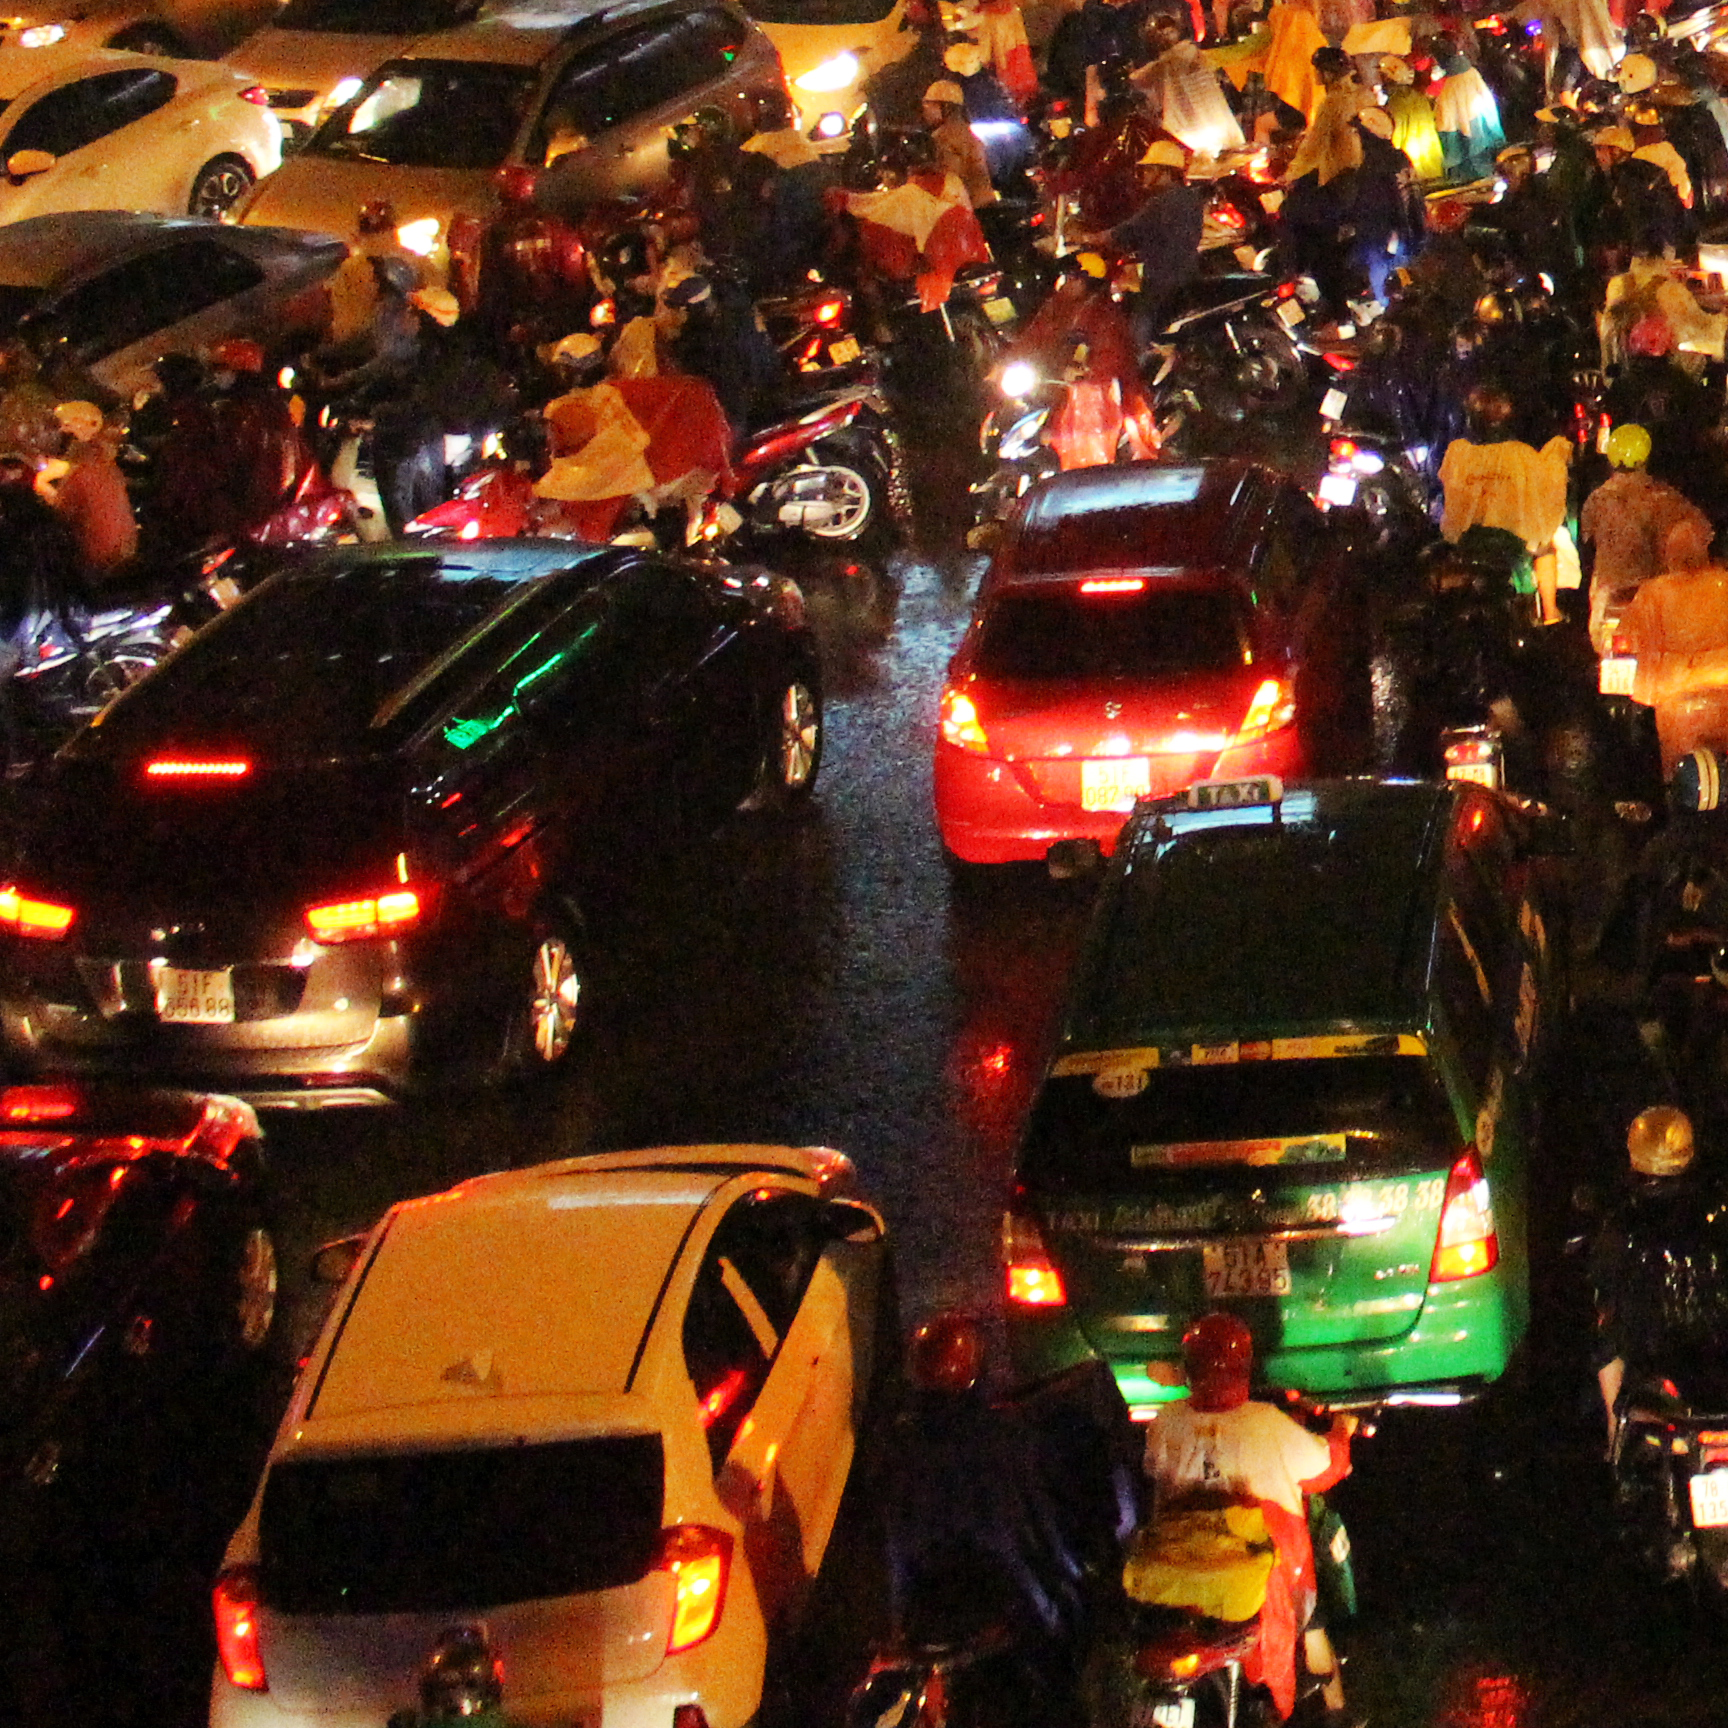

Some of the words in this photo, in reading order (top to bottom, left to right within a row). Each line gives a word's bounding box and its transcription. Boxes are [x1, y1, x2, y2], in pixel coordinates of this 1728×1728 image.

[1208, 781, 1260, 802] TAXI
[1379, 1183, 1410, 1216] 38
[1415, 1177, 1446, 1210] 38
